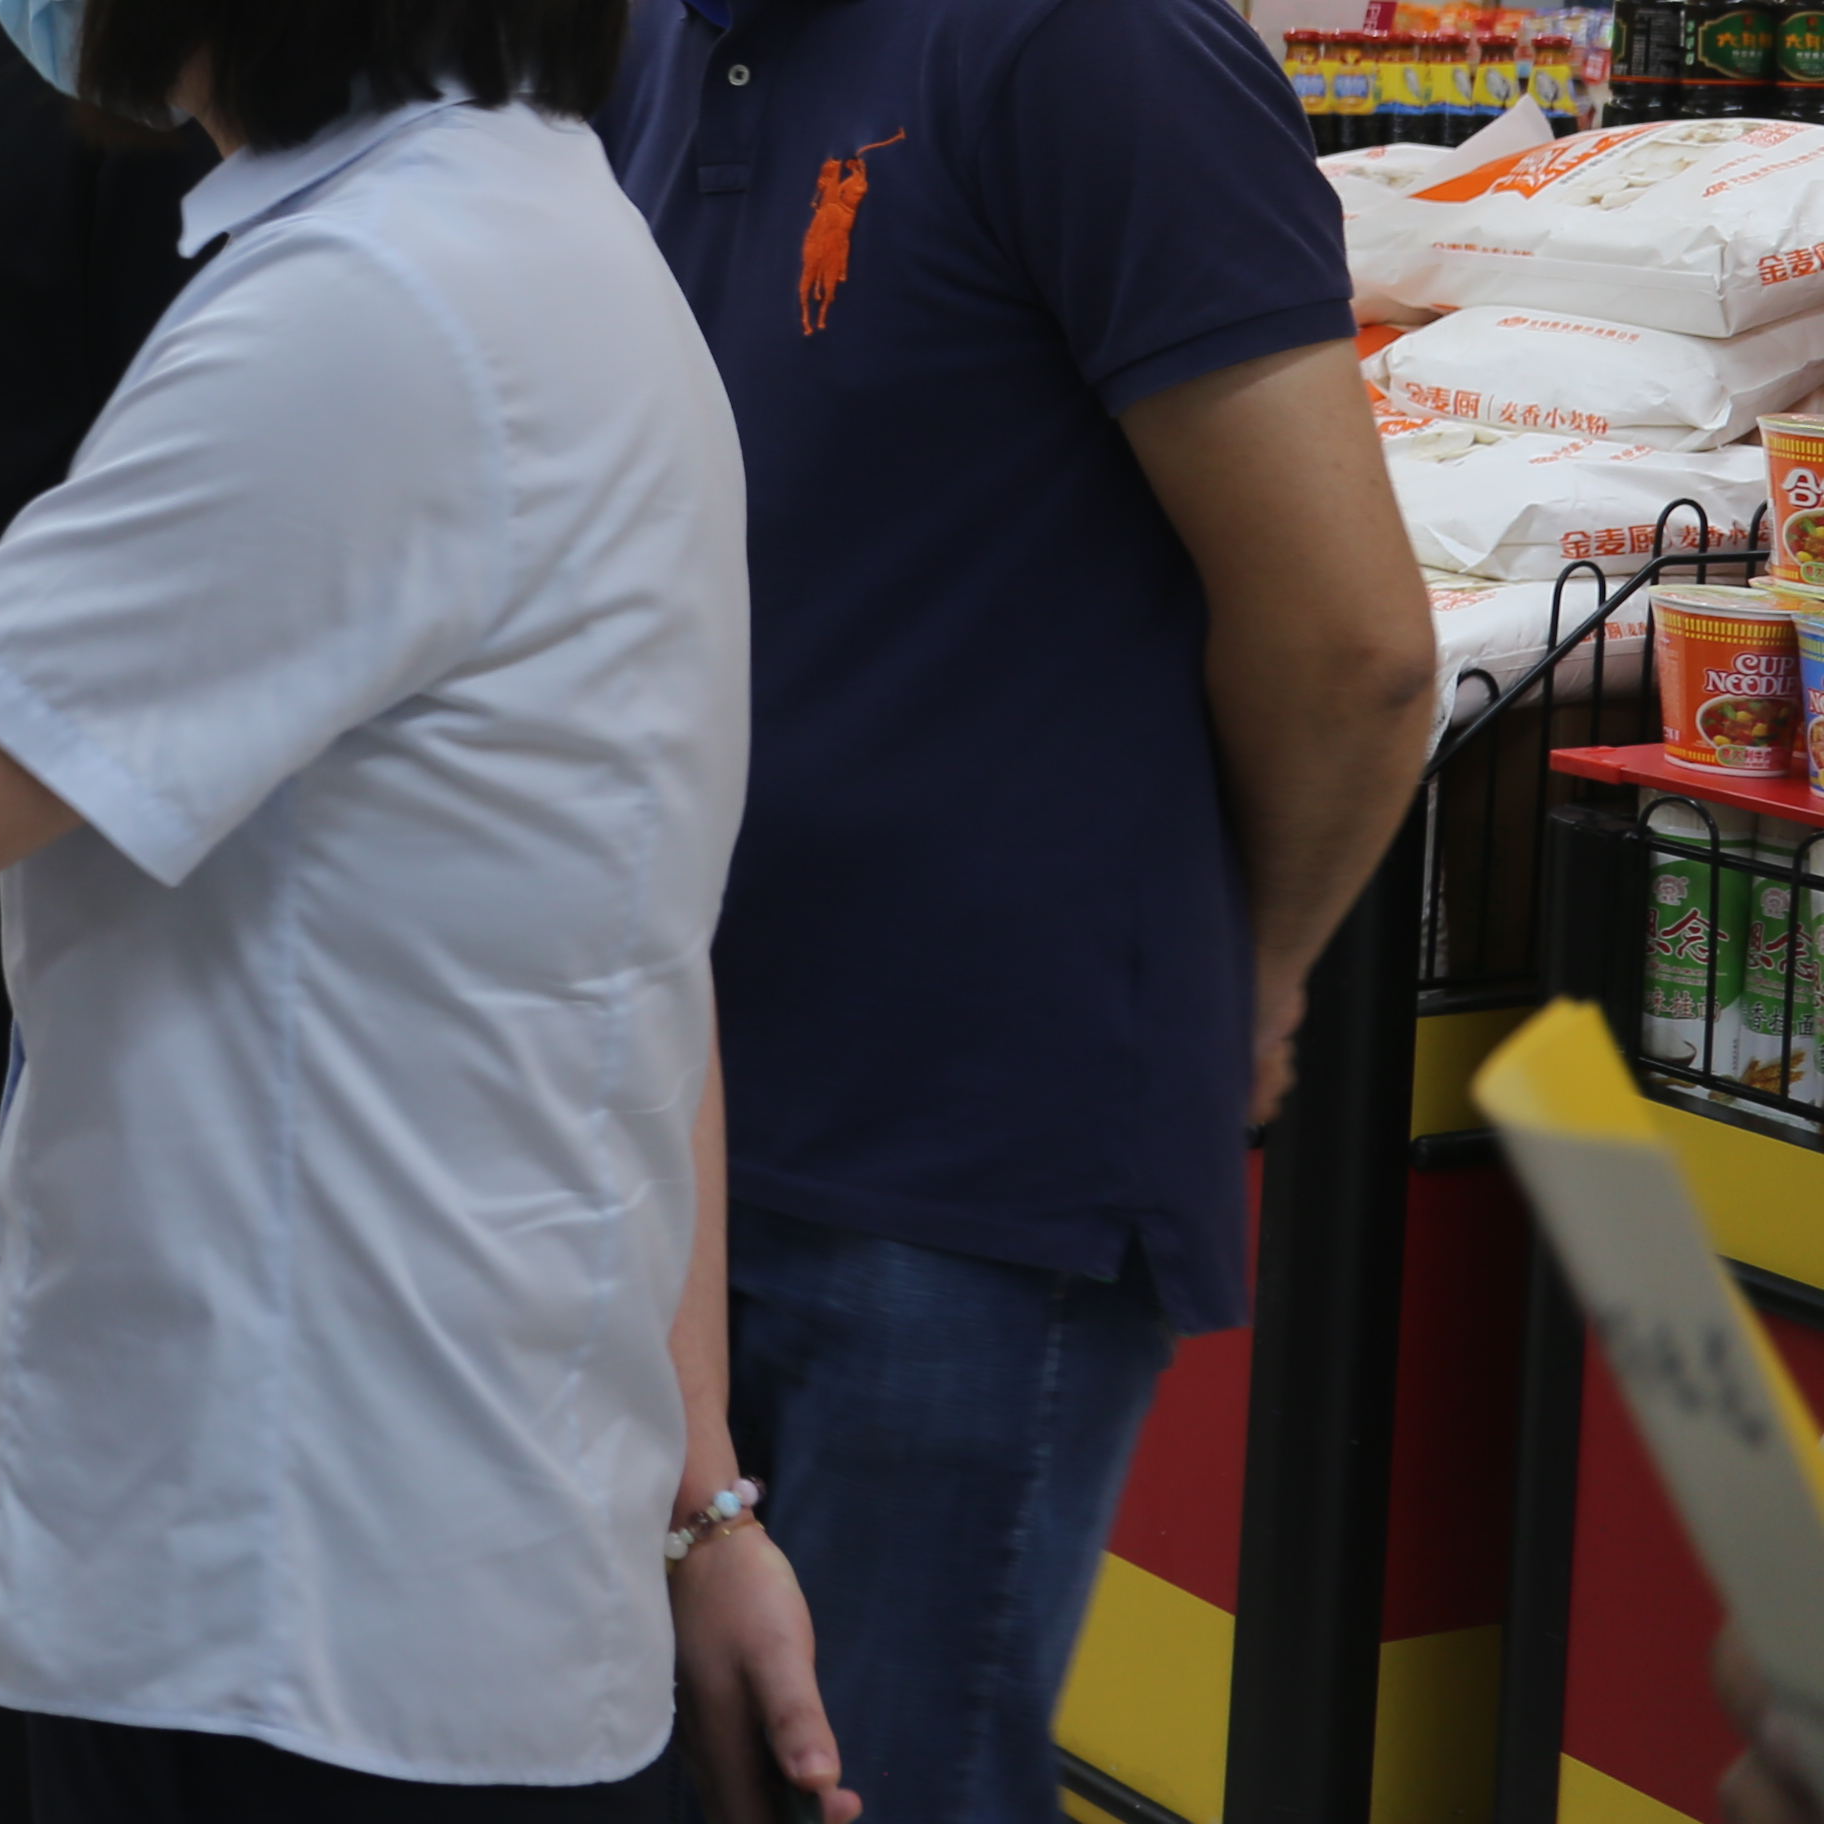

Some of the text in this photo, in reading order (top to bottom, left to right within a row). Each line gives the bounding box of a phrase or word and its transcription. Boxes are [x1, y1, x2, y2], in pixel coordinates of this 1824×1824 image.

[1405, 381, 1610, 436] 金麦厨 麦香小麦粉
[1781, 467, 1824, 508] 合
[1558, 523, 1656, 560] 金麦厨
[1705, 669, 1797, 696] NOODLE
[1734, 653, 1795, 676] CUP
